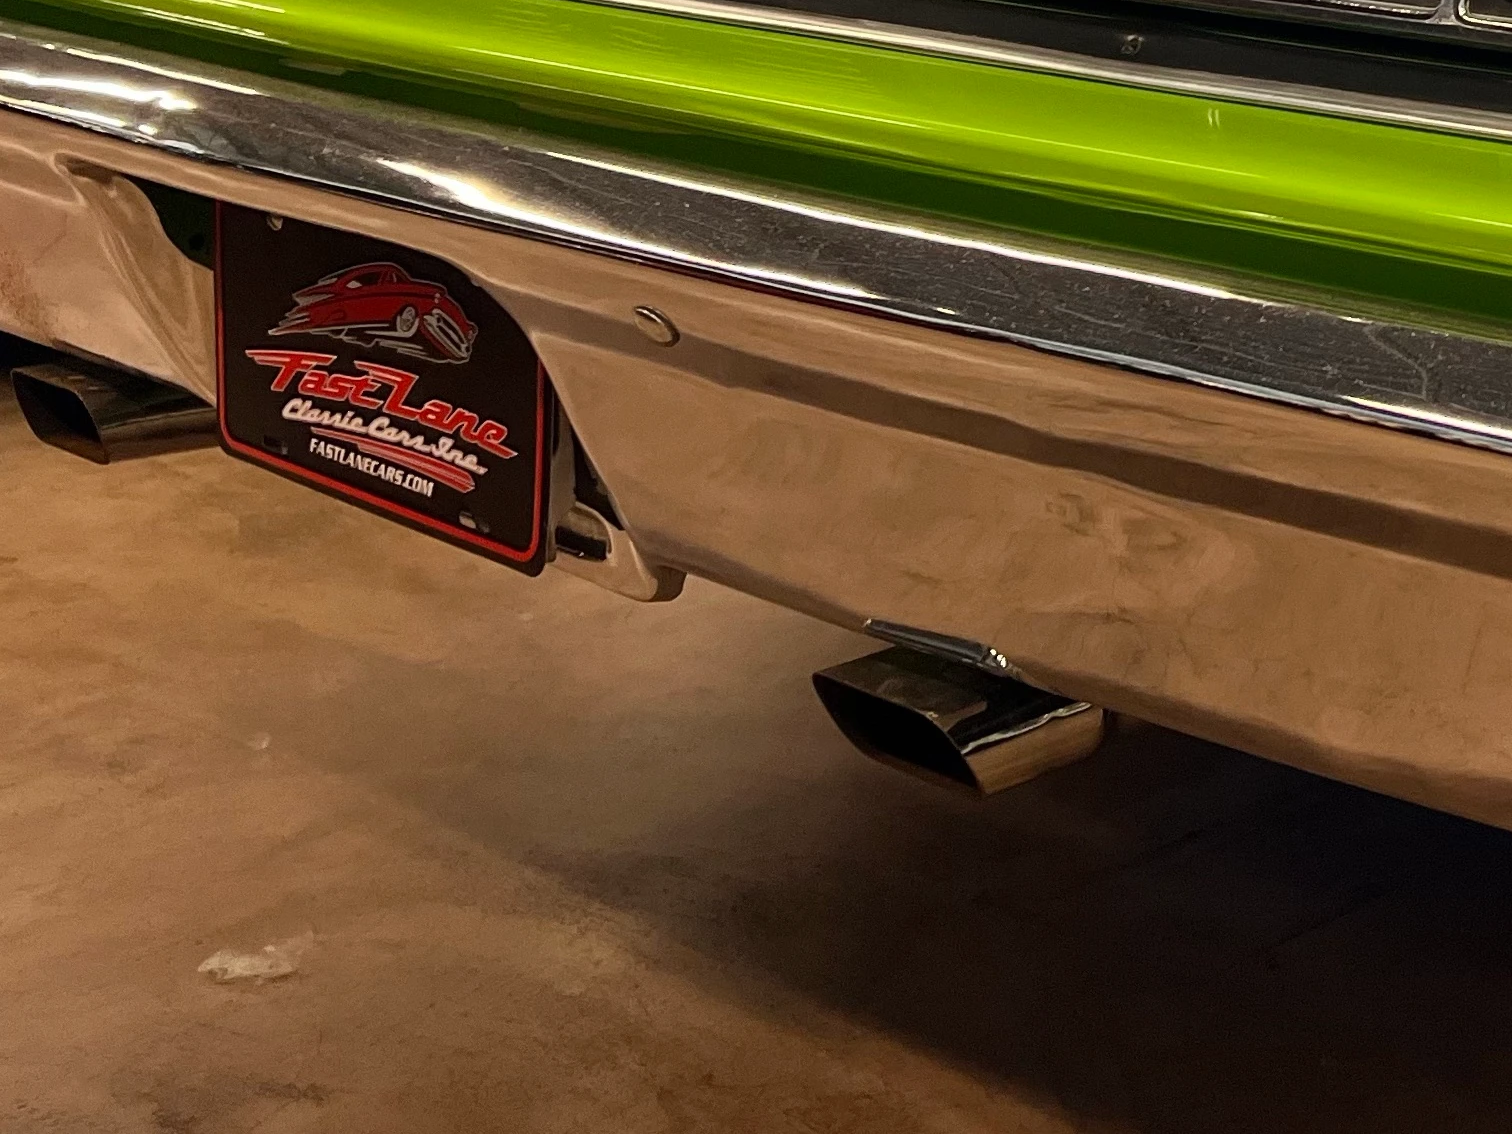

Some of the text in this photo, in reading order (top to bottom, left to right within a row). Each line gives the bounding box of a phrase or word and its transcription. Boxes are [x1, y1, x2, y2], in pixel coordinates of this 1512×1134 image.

[282, 398, 368, 434] Classic
[367, 416, 432, 453] Cars
[309, 437, 434, 498] FASTLANECARS.COM
